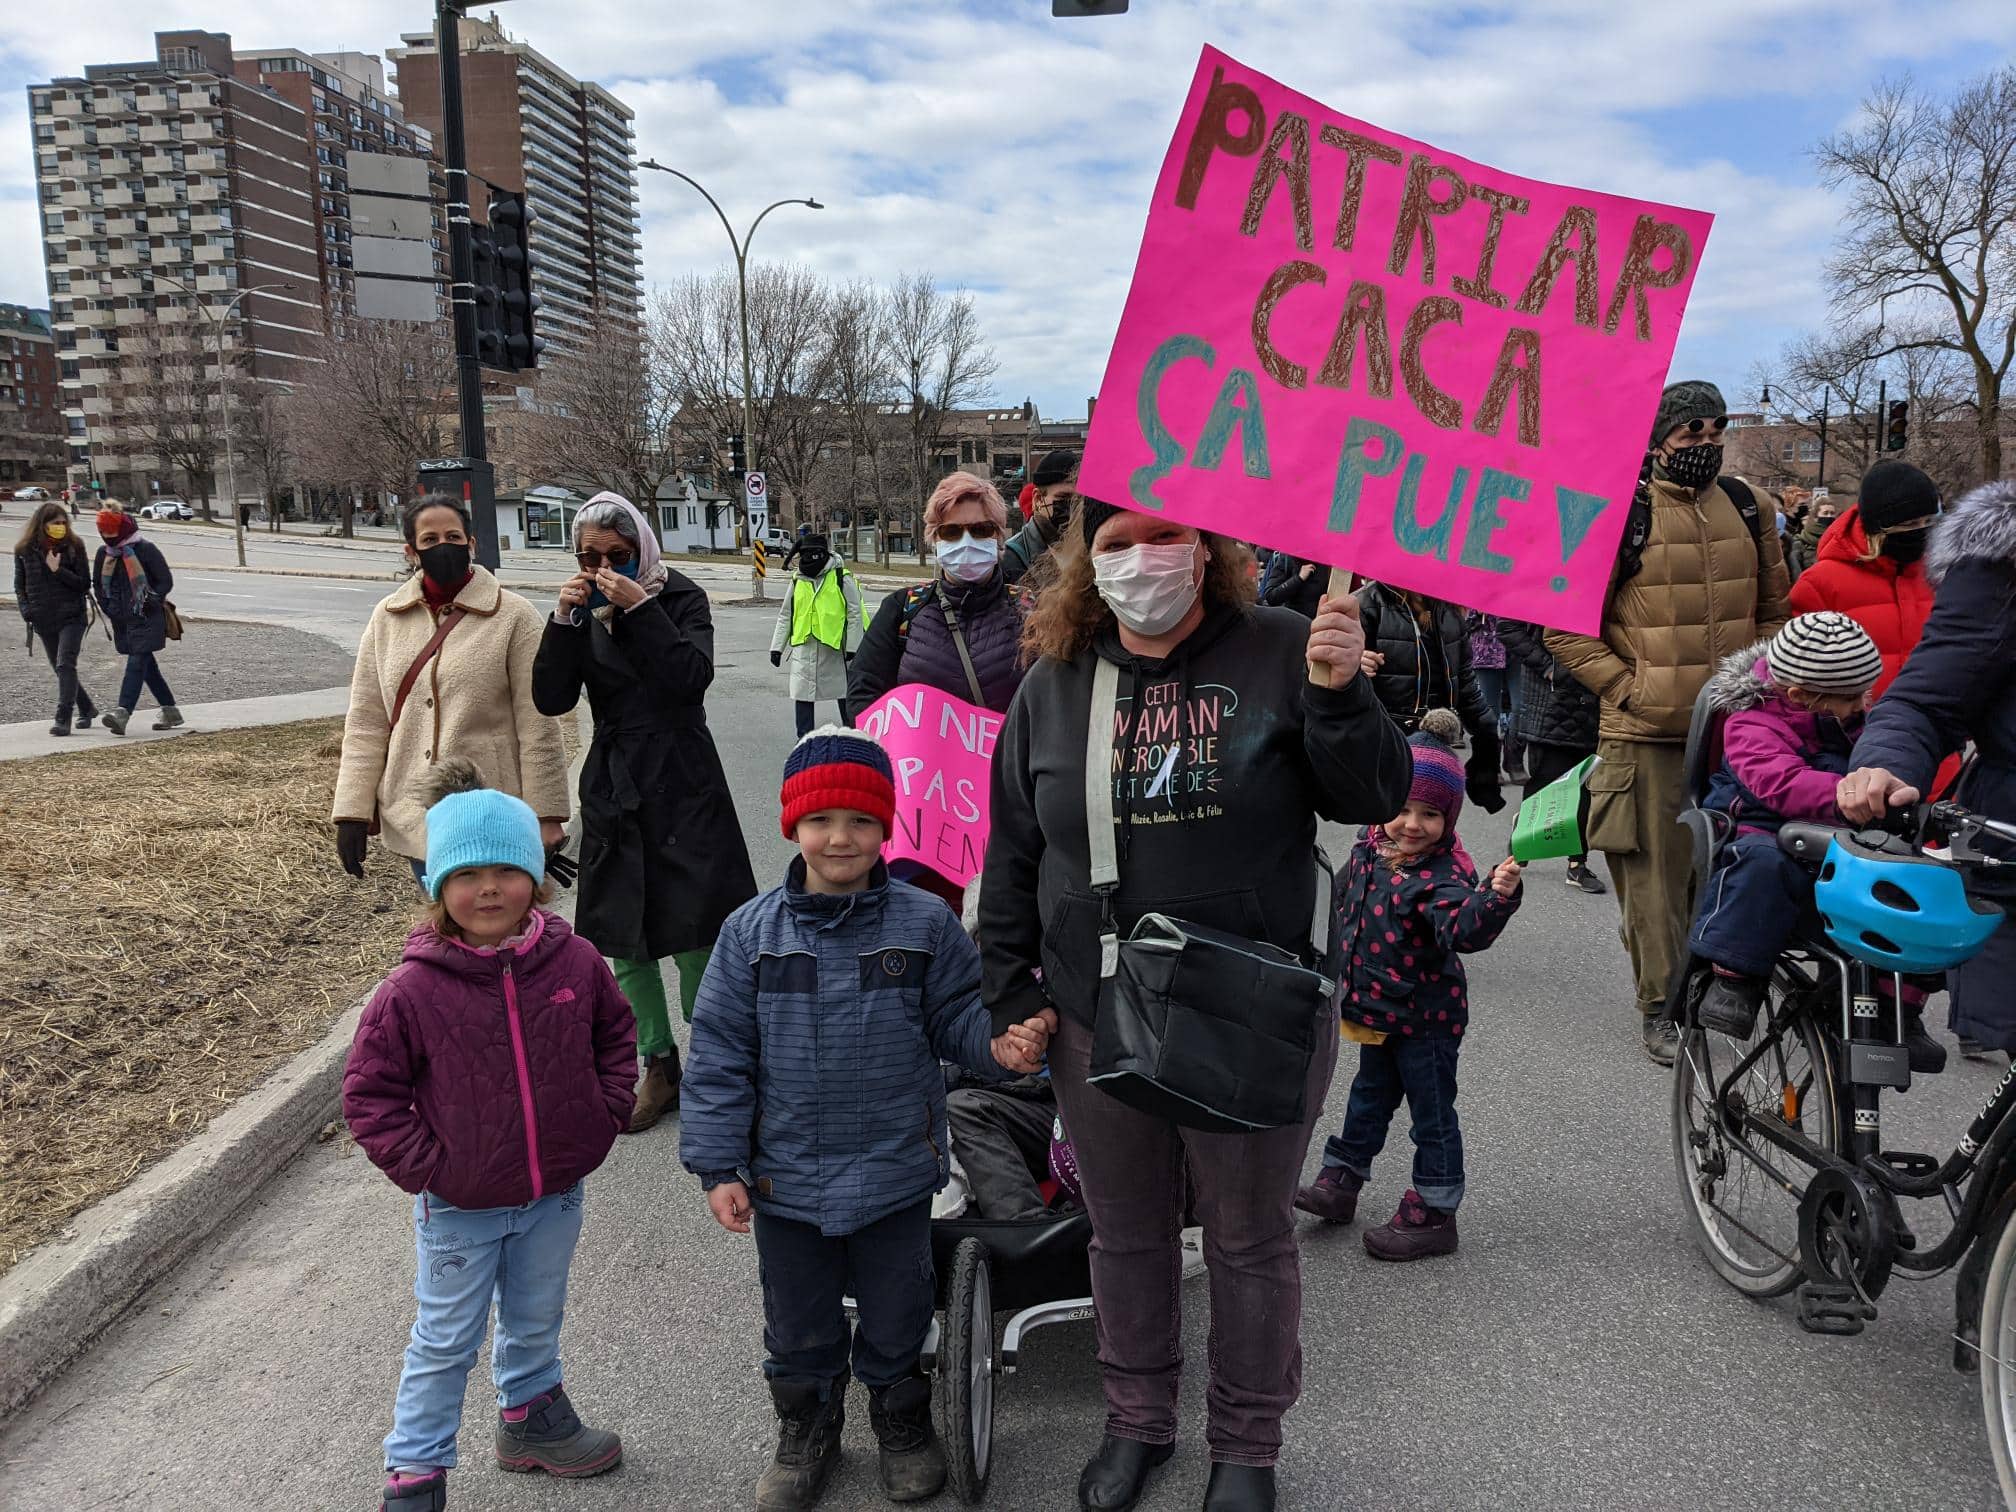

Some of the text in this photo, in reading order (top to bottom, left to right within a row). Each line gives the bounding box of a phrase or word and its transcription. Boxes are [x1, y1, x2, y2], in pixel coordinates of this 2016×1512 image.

[1174, 65, 1693, 342] PATRIAR
[1251, 259, 1541, 448] CACA
[1128, 333, 1272, 510] ÇA
[864, 691, 1000, 759] ON NE
[1144, 682, 1181, 706] CETT
[897, 757, 981, 823] PAS
[1187, 771, 1204, 793] DE
[1196, 806, 1205, 818] &
